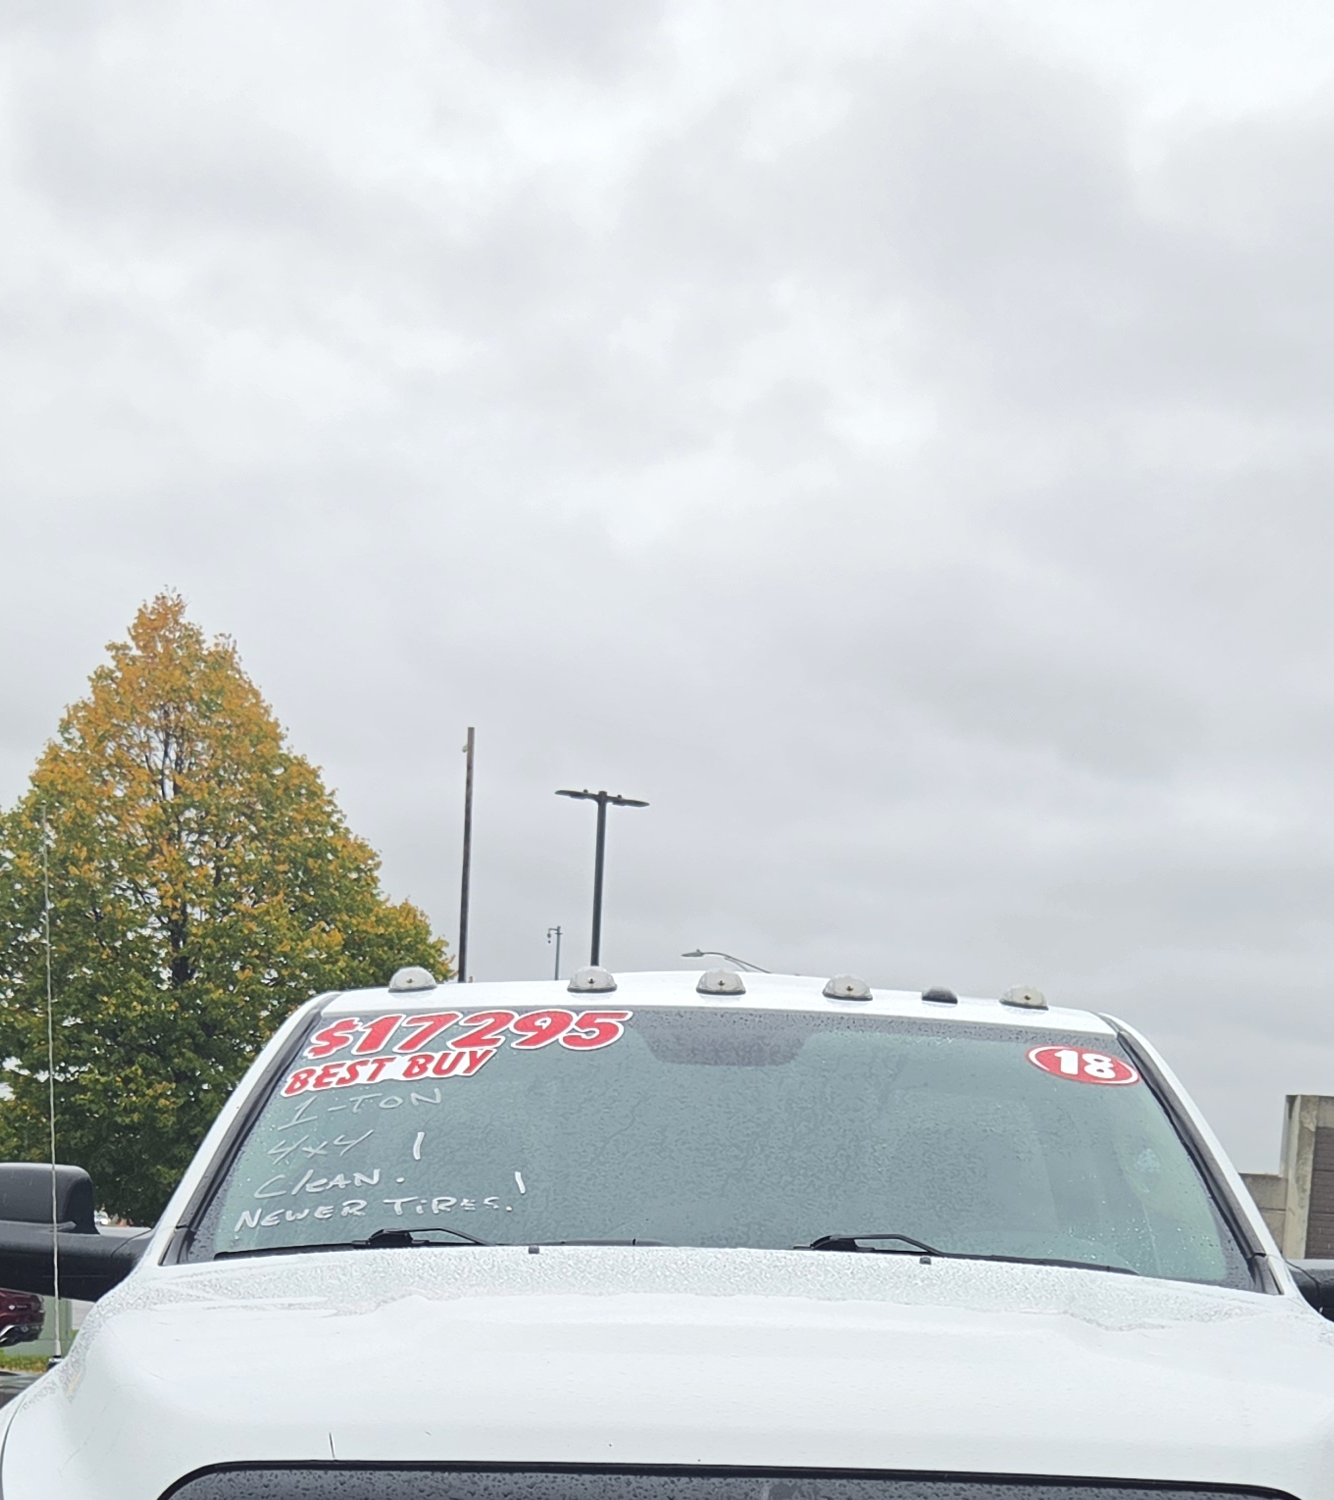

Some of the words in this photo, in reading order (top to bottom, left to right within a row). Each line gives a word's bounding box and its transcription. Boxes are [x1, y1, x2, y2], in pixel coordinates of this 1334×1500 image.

[303, 1010, 633, 1059] $17295
[282, 1056, 397, 1096] BEST
[402, 1049, 496, 1080] BUY
[1054, 1049, 1116, 1079] 18
